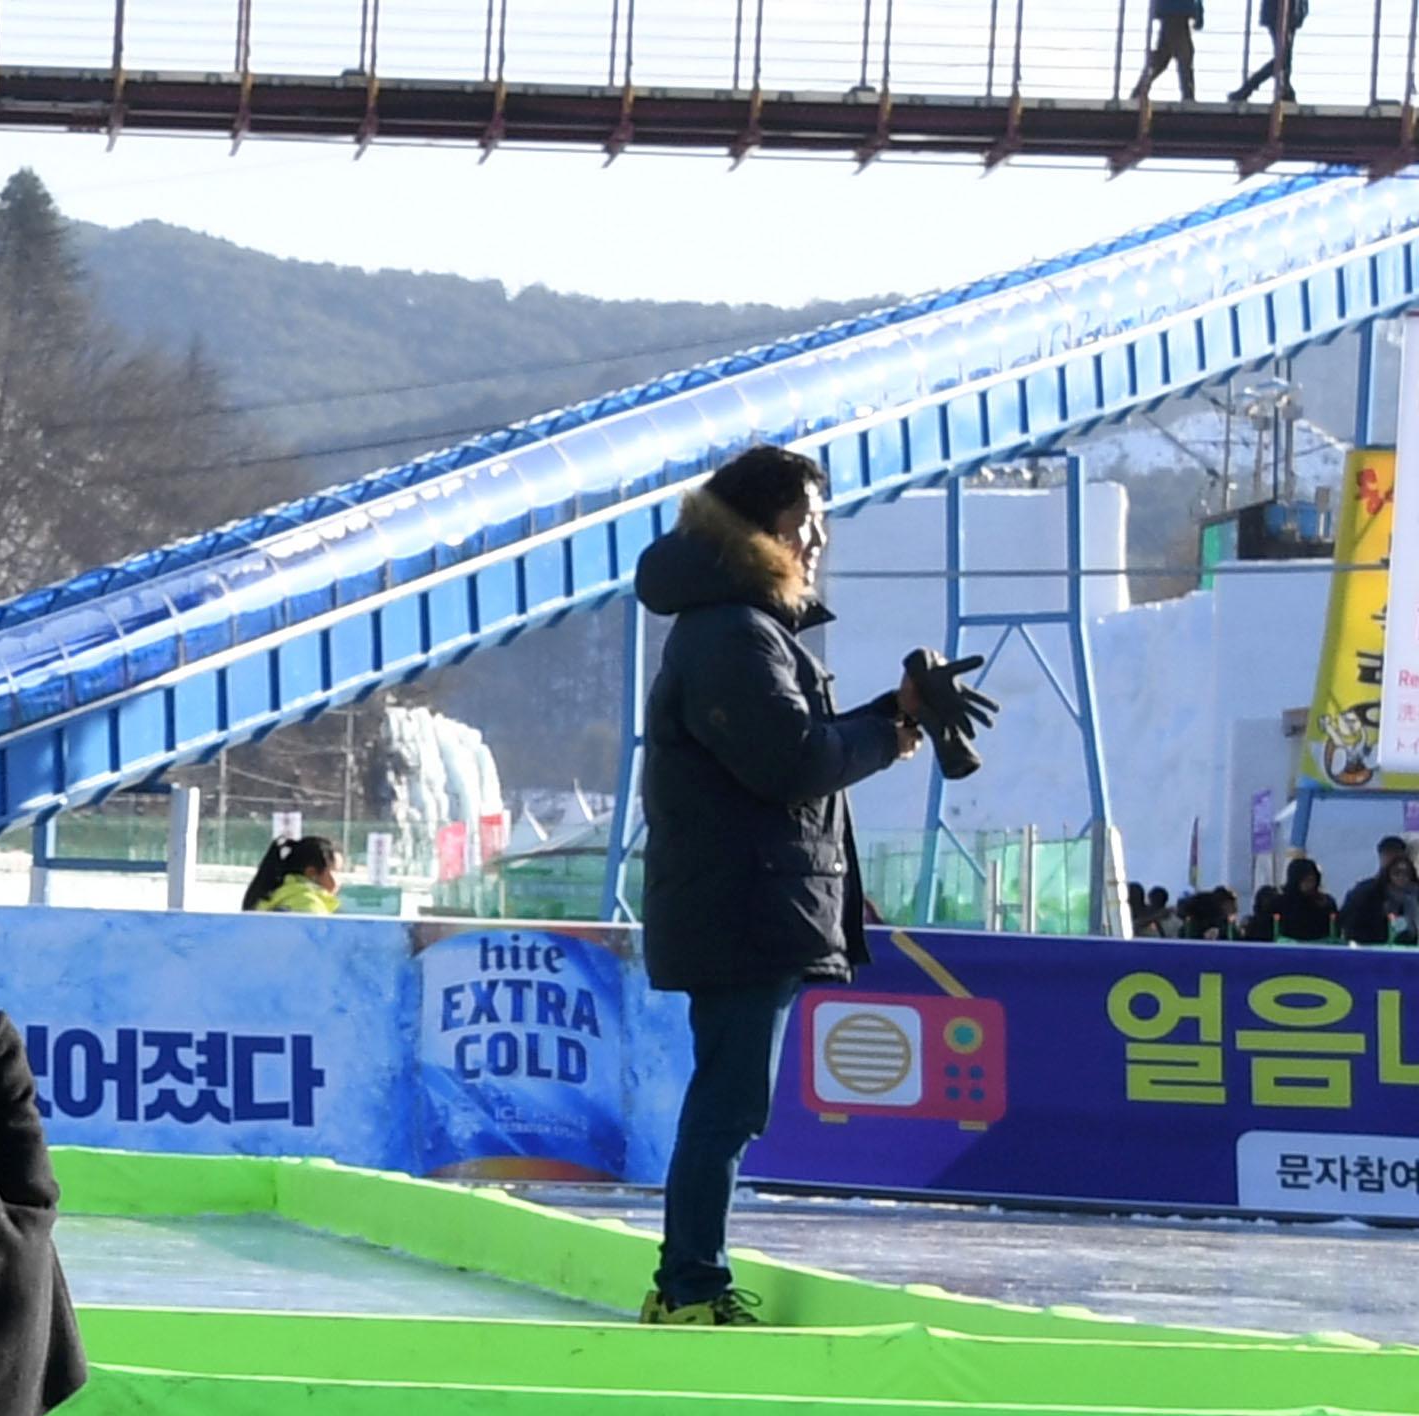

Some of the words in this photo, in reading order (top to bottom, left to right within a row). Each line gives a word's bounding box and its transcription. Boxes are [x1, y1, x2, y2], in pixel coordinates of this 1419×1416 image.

[479, 934, 566, 973] hite
[441, 979, 602, 1039] EXTRA
[454, 1031, 588, 1085] COLD
